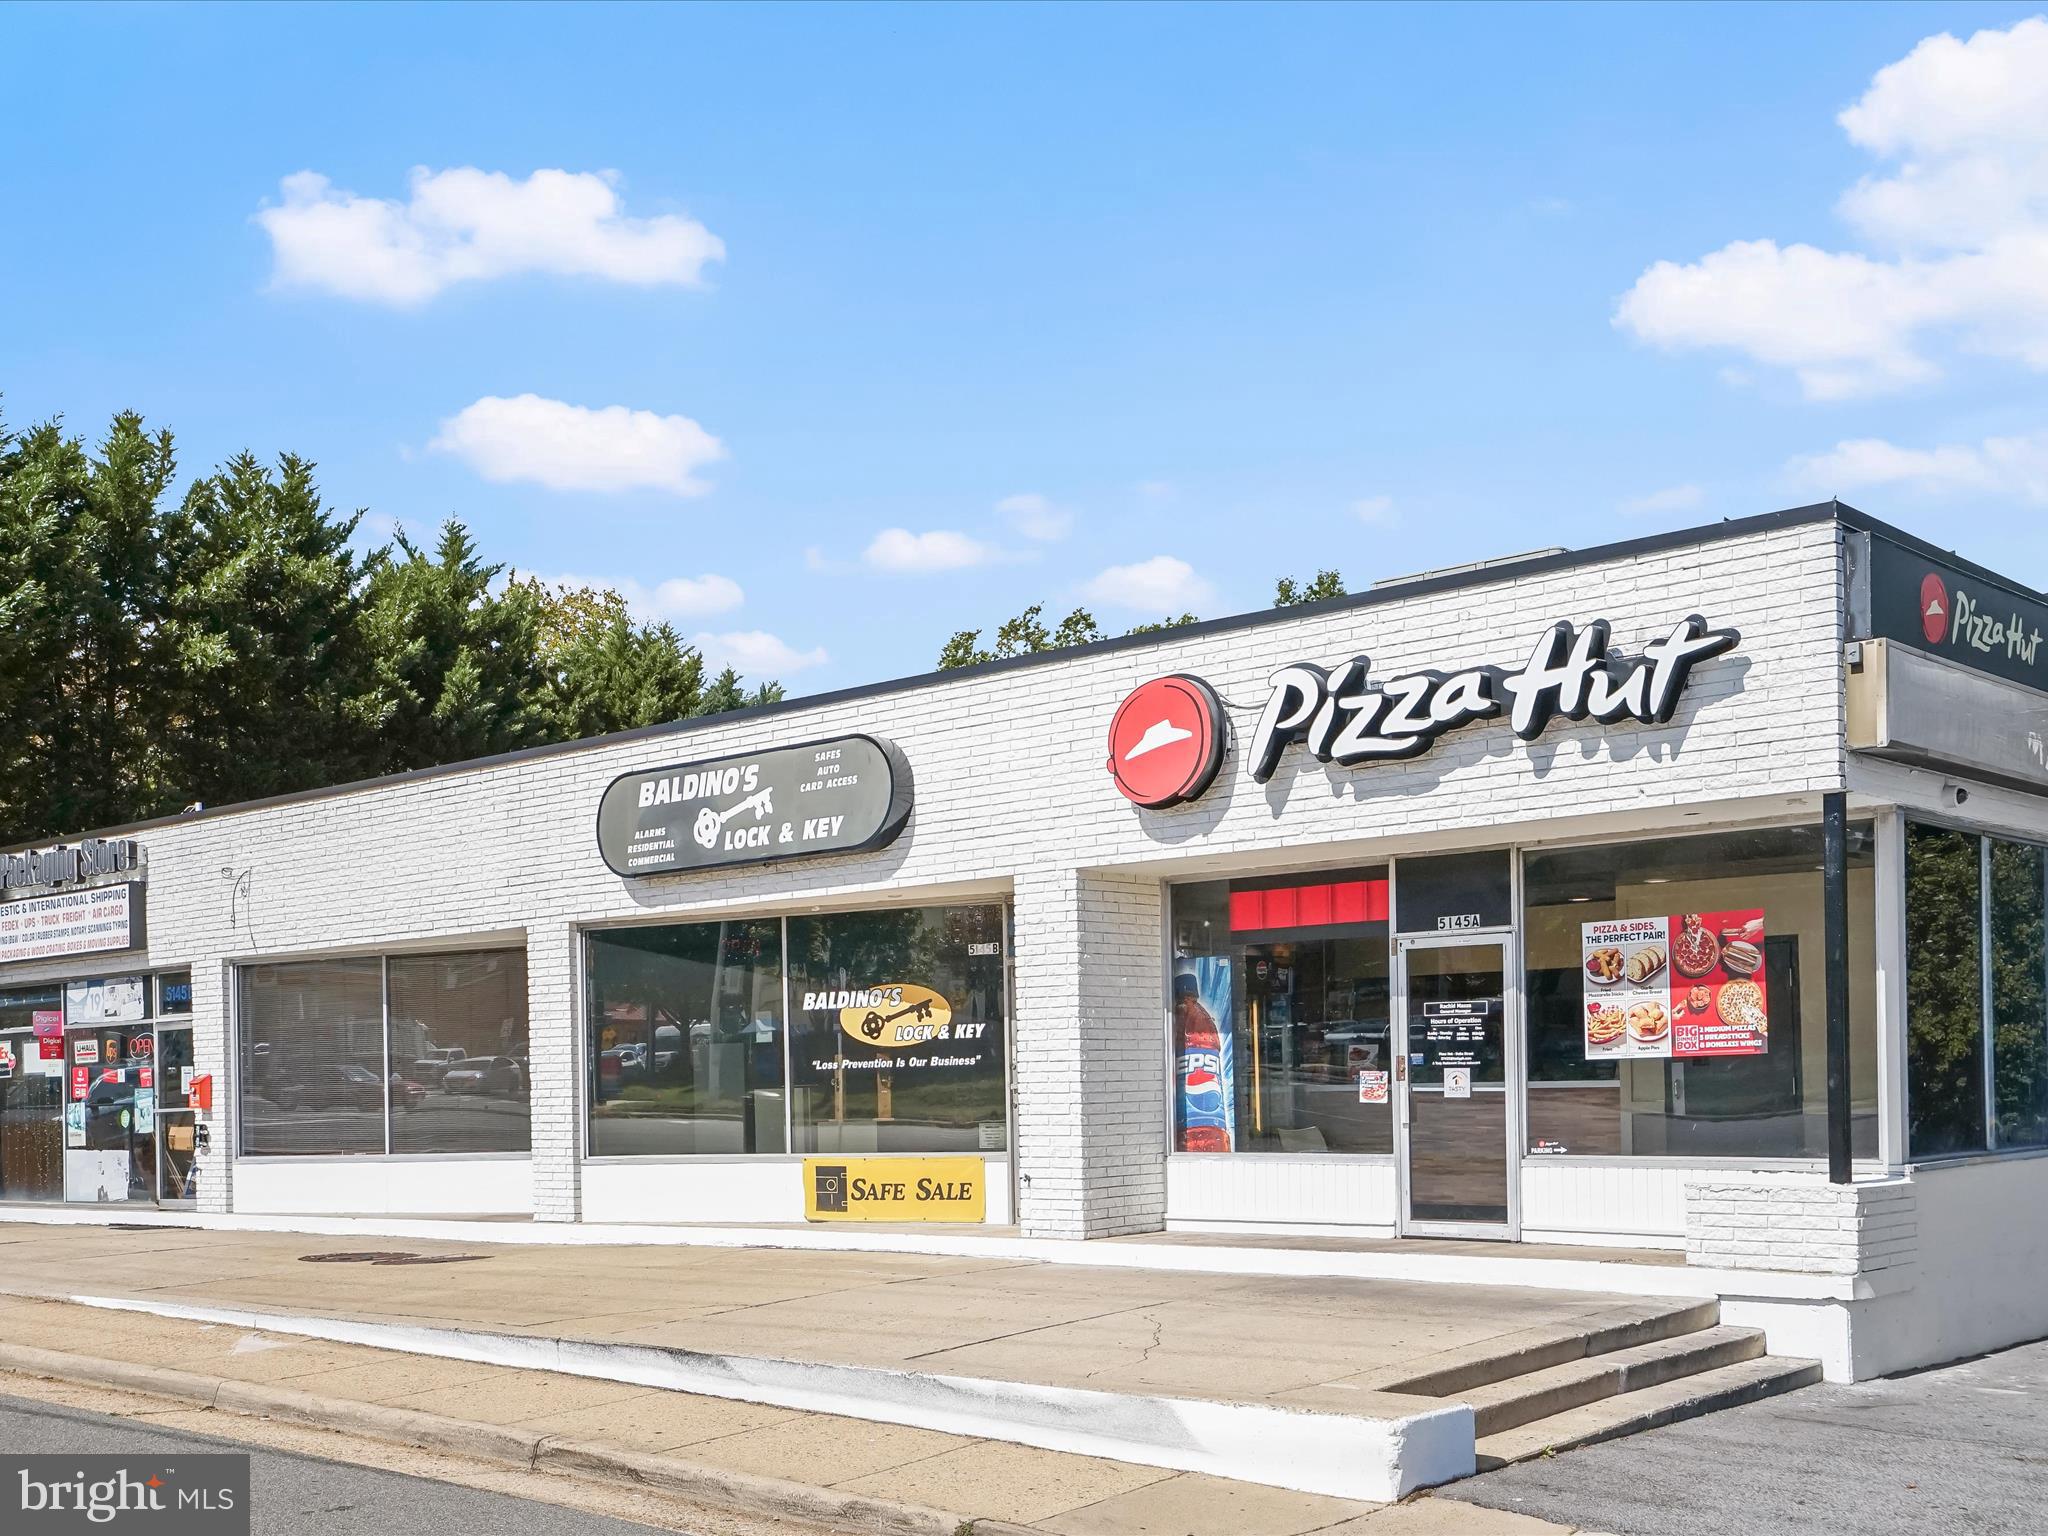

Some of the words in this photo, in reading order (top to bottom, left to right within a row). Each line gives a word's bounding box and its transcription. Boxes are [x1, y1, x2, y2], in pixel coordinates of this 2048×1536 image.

[1952, 591, 2005, 652] Pizza
[2006, 613, 2043, 666] Hut
[1247, 657, 1501, 780] Pizza
[1503, 614, 1740, 739] Hut
[815, 749, 841, 762] SAFES
[817, 764, 840, 776] AUTO
[638, 763, 759, 808] BALDINO'S
[800, 779, 823, 793] CARD
[826, 775, 858, 789] ACCESS
[634, 827, 666, 840] ALARMS
[724, 825, 771, 851] LOCK
[778, 822, 793, 843] &
[802, 815, 844, 841] KEY
[627, 839, 675, 854] RESIDENTIAL
[80, 839, 129, 877] Store
[627, 852, 675, 867] COMMERCIAL
[22, 903, 27, 914] &
[29, 894, 88, 912] INTERNATIONAL
[91, 888, 127, 904] SHIPPING
[2, 920, 19, 931] FEDEX
[24, 917, 36, 928] UPS
[41, 914, 60, 926] TRUCK
[62, 910, 86, 923] FREIGHT
[92, 907, 103, 919] AIR
[103, 904, 124, 918] CARGO
[1439, 916, 1479, 929] 5145A
[1593, 925, 1618, 935] PIZZA
[1620, 923, 1629, 933] &
[1586, 935, 1602, 944] THE
[1603, 933, 1642, 943] PERFECT
[1643, 931, 1665, 940] PAIR!
[803, 987, 902, 1011] BALDINO'S
[1454, 1017, 1482, 1025] Operation
[895, 1025, 933, 1042] LOCK
[937, 1024, 950, 1039] &
[955, 1023, 985, 1039] KEY
[1676, 1026, 1698, 1036] BIG
[1676, 1041, 1698, 1049] BOX
[841, 1058, 893, 1069] Prevention
[896, 1057, 905, 1067] Is
[909, 1056, 927, 1067] Our
[851, 1178, 905, 1200] SAFE
[916, 1178, 972, 1200] SALE
